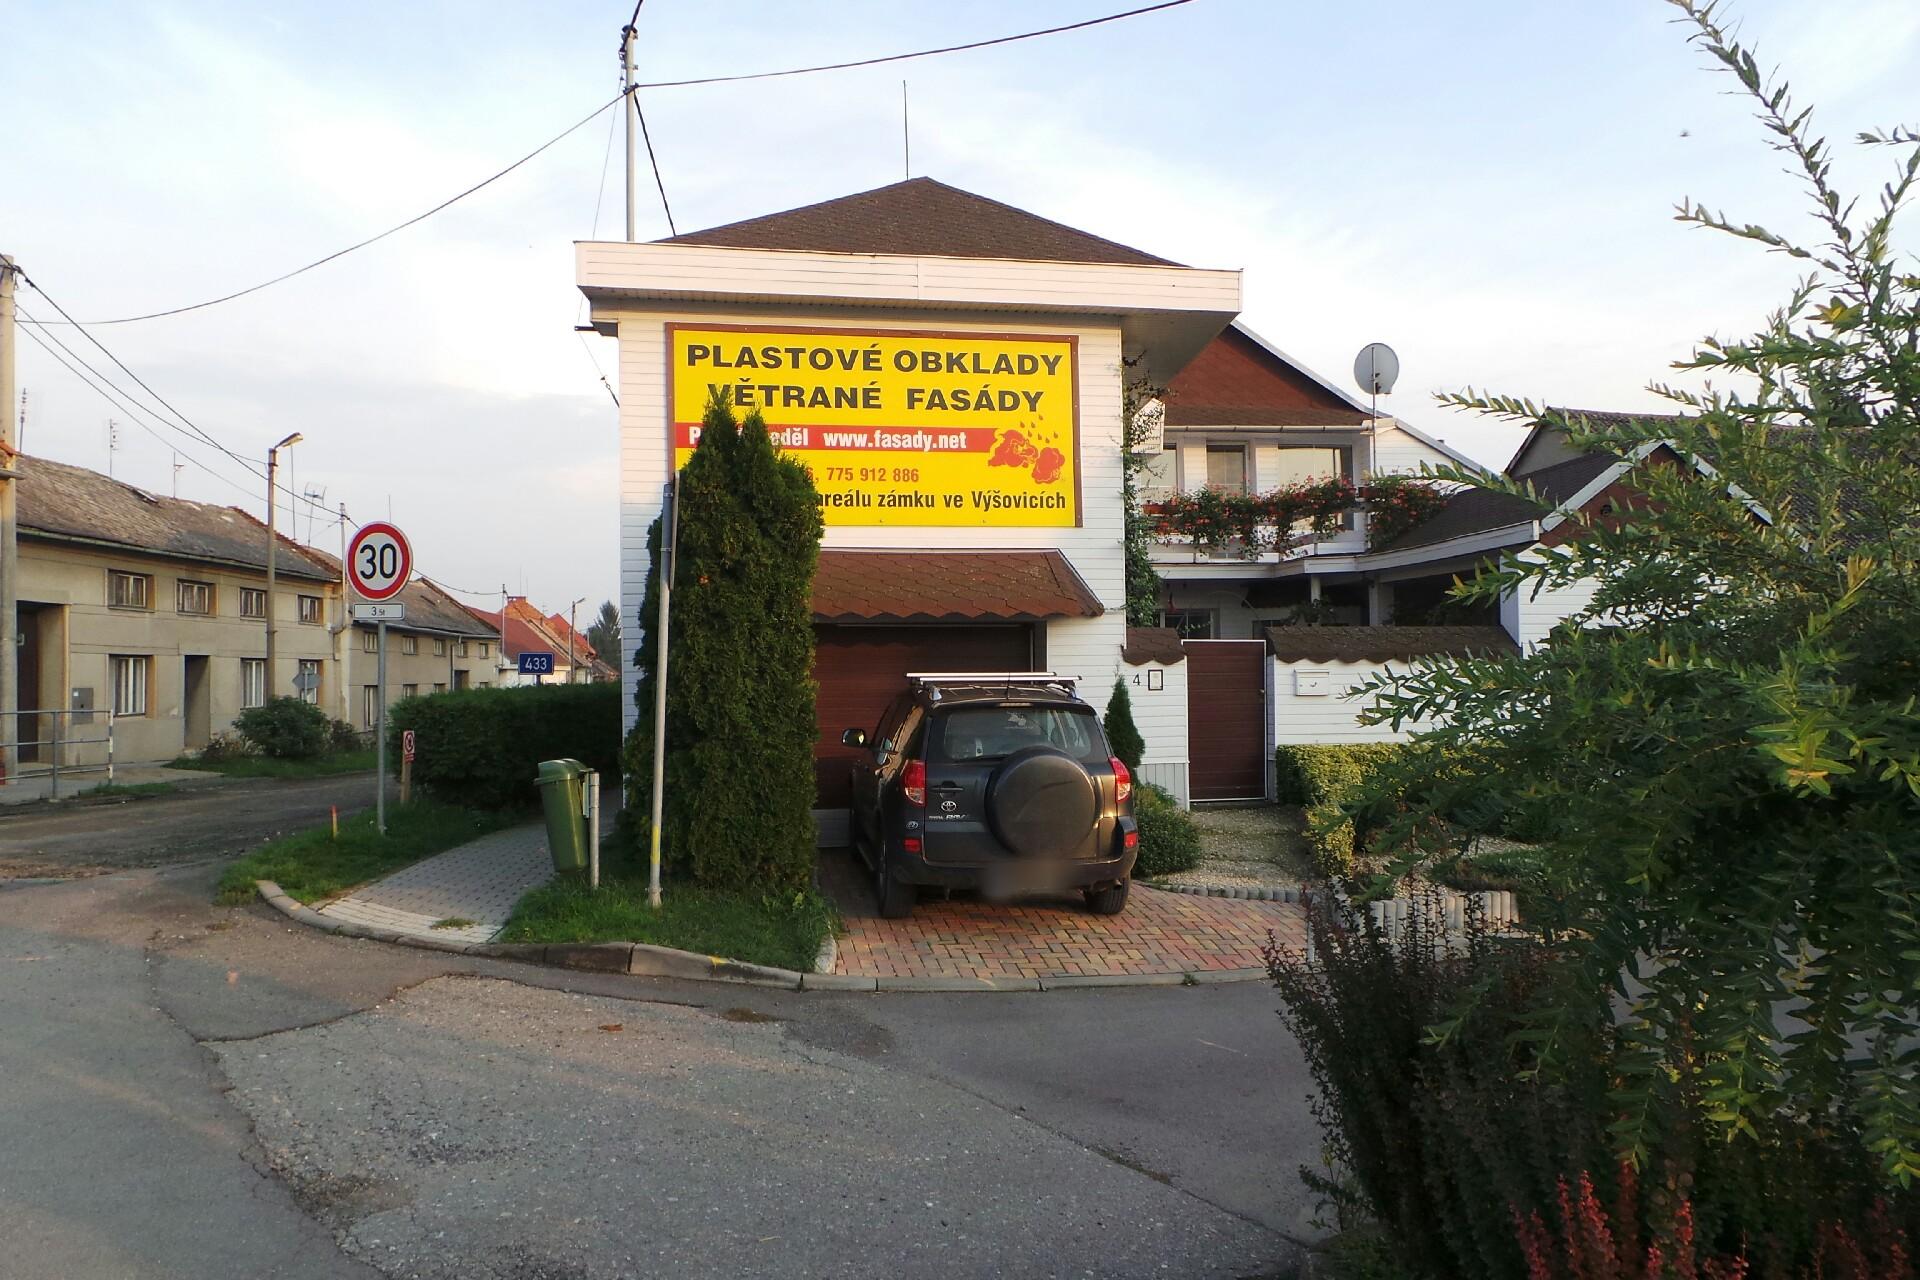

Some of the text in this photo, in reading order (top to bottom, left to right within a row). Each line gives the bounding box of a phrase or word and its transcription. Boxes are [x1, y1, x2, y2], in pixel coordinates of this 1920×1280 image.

[687, 343, 1063, 376] PLASTOVÉ OBKLADY
[707, 377, 1045, 412] VĚTRANÉ FASÁDY
[823, 429, 967, 452] www.fasady.net
[826, 467, 854, 482] 775
[860, 468, 887, 482] 912
[893, 468, 920, 483] 886
[877, 490, 935, 508] zámku
[943, 494, 964, 509] ve
[971, 490, 1066, 512] Výšovicích
[359, 543, 398, 580] 30
[525, 657, 547, 671] 433
[1132, 673, 1141, 686] 4
